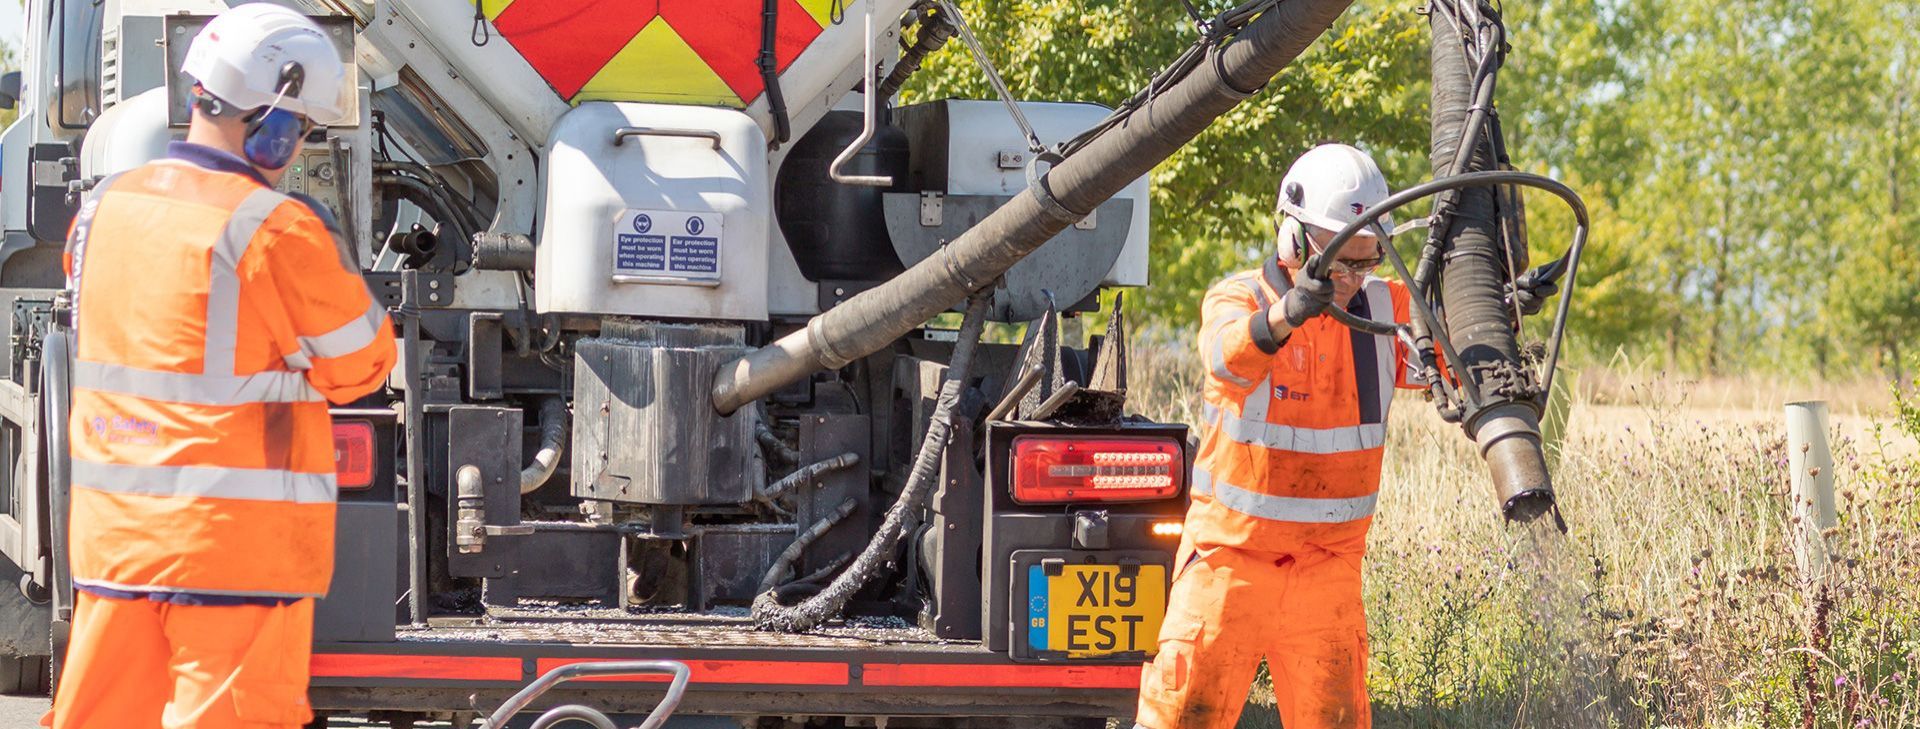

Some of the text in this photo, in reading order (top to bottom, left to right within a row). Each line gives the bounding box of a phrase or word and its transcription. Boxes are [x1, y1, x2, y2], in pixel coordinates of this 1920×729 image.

[620, 236, 664, 245] Eye protection
[684, 239, 716, 247] protection
[1076, 571, 1137, 607] X19
[1031, 617, 1046, 628] GB
[1068, 615, 1144, 650] EST
